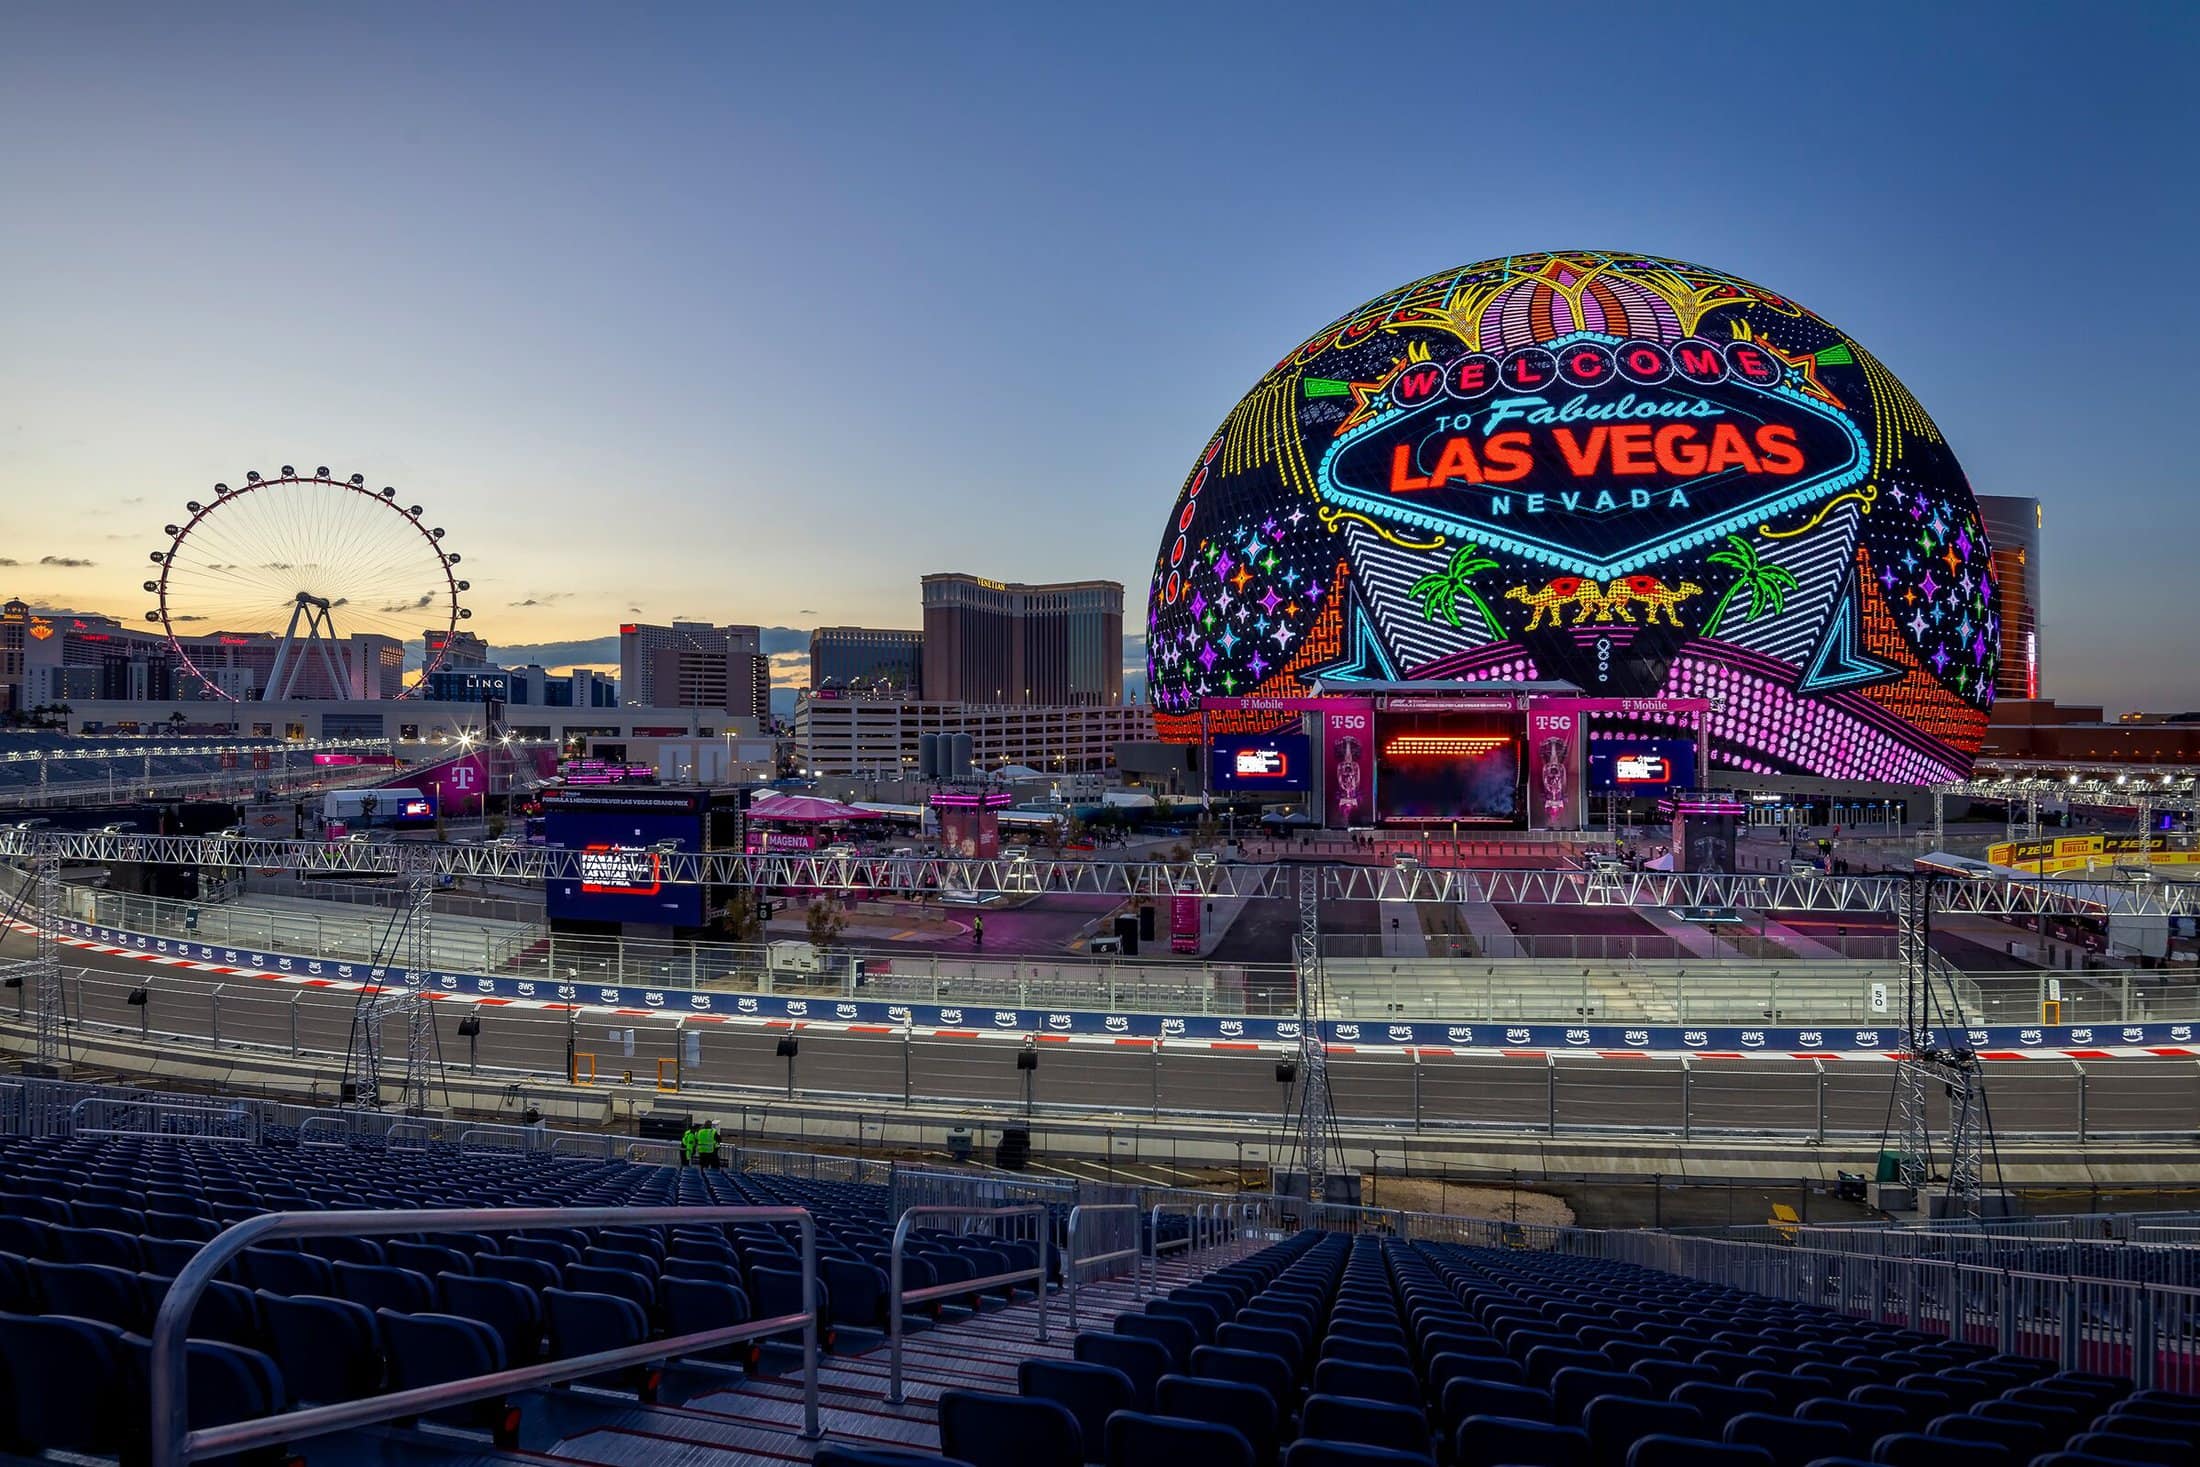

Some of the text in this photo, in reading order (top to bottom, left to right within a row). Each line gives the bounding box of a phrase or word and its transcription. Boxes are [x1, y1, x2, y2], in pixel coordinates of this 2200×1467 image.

[1402, 349, 1769, 398] WELCOME
[1436, 393, 1725, 436] TO Fabulous
[1391, 423, 1805, 492] LAS VEGAS
[1491, 488, 1691, 515] NEVADA
[466, 680, 504, 689] LINQ
[1251, 700, 1284, 709] Mobile
[1633, 700, 1668, 710] Mobile
[1344, 715, 1366, 729] 5G
[1549, 716, 1571, 730] 5G
[768, 835, 809, 848] MAGENTA
[2105, 840, 2118, 849] P
[2018, 847, 2026, 856] P
[442, 976, 456, 984] aws
[479, 979, 494, 987] aws
[518, 983, 534, 991] aws
[601, 989, 618, 997] aws
[646, 993, 663, 1001] aws
[691, 995, 710, 1004] aws
[738, 998, 757, 1007] aws
[787, 1001, 806, 1010] aws
[837, 1004, 856, 1013] aws
[889, 1007, 909, 1016] aws
[941, 1009, 961, 1018] aws
[995, 1012, 1016, 1021] aws
[1050, 1015, 1071, 1024] aws
[1106, 1017, 1127, 1026] aws
[1161, 1019, 1184, 1028] aws
[1220, 1021, 1242, 1030] aws
[1277, 1023, 1301, 1032] aws
[1337, 1025, 1359, 1034] aws
[1389, 1026, 1412, 1035] aws
[1449, 1027, 1471, 1037] aws
[2123, 1028, 2142, 1036] aws
[2171, 1025, 2191, 1035] aws
[1507, 1029, 1529, 1038] aws
[1567, 1030, 1589, 1039] aws
[1625, 1031, 1648, 1040] aws
[1685, 1032, 1707, 1041] aws
[1742, 1032, 1764, 1041] aws
[1800, 1032, 1821, 1041] aws
[1856, 1032, 1877, 1041] aws
[2021, 1030, 2041, 1039] aws
[2072, 1029, 2092, 1038] aws
